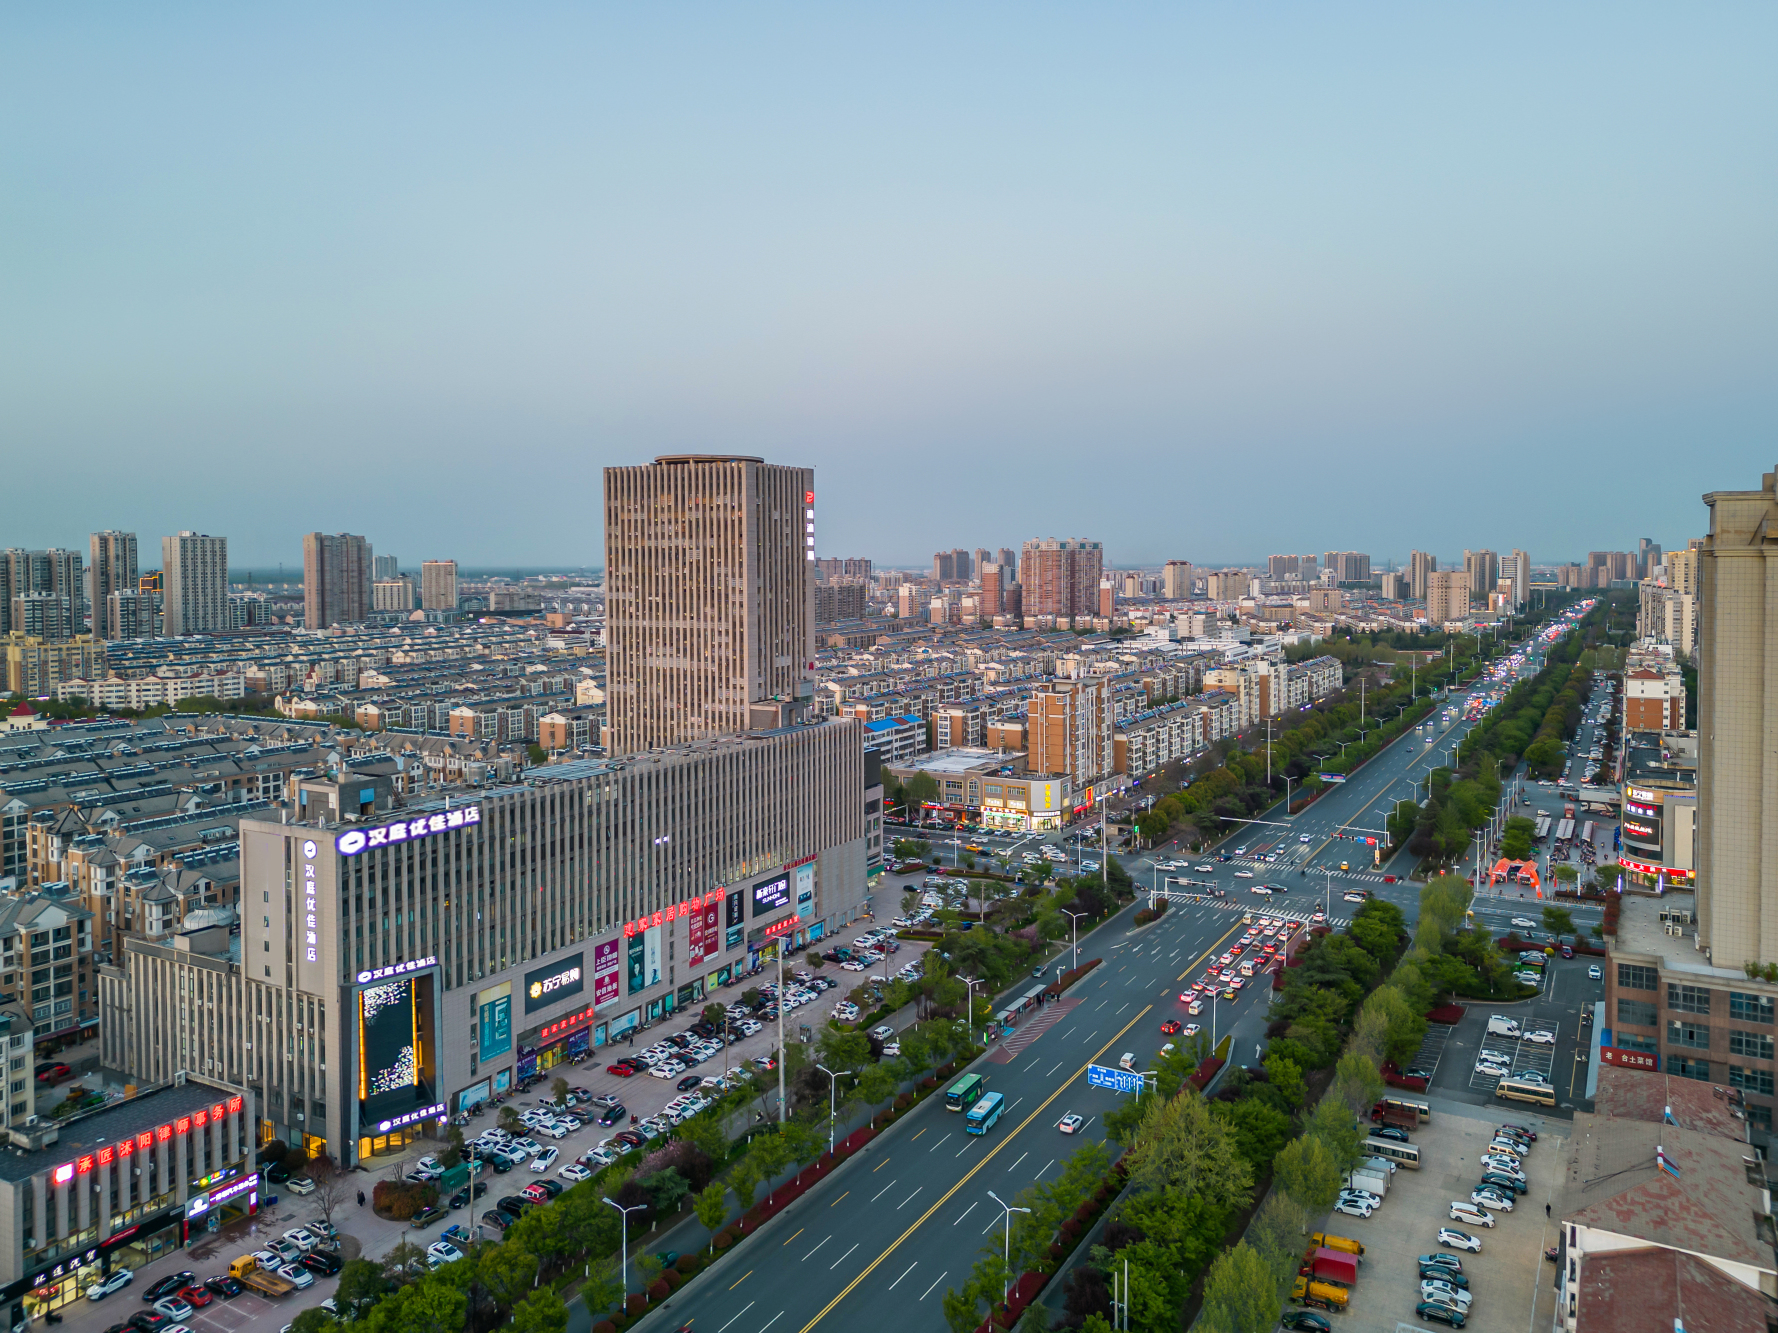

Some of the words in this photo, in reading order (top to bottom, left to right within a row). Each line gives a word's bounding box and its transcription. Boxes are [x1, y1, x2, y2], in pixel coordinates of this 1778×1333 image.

[368, 806, 480, 846] 汉庭优佳酒店
[304, 863, 317, 962] 汉庭优佳酒店
[372, 956, 436, 979] 汉庭优佳酒店
[542, 967, 580, 993] 苏宁易购
[392, 1103, 445, 1127] 汉庭优佳酒店
[77, 1096, 243, 1173] 承匠沭阳律师事务所
